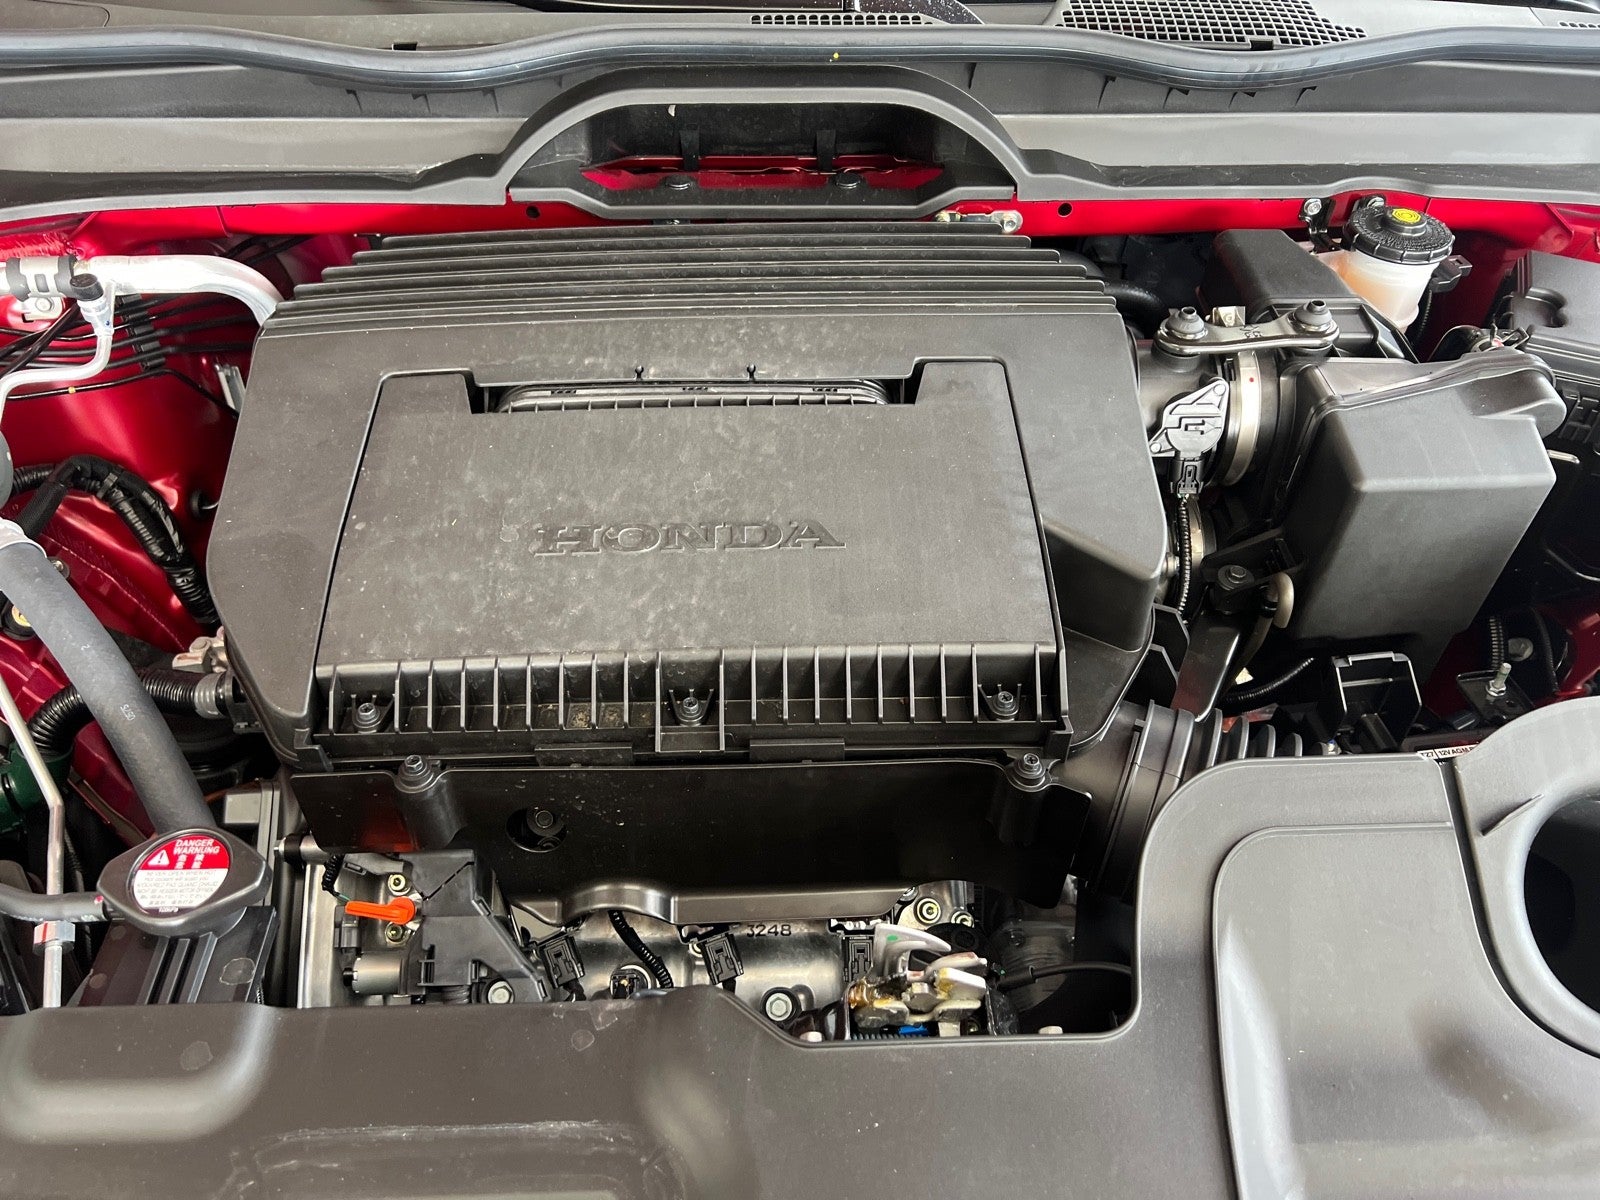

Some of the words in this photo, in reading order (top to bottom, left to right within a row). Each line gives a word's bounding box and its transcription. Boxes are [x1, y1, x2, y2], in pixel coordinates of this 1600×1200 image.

[529, 521, 846, 556] HONDA
[175, 838, 214, 847] DANGER
[173, 846, 221, 855] WARNUNG
[746, 924, 792, 938] 3248
